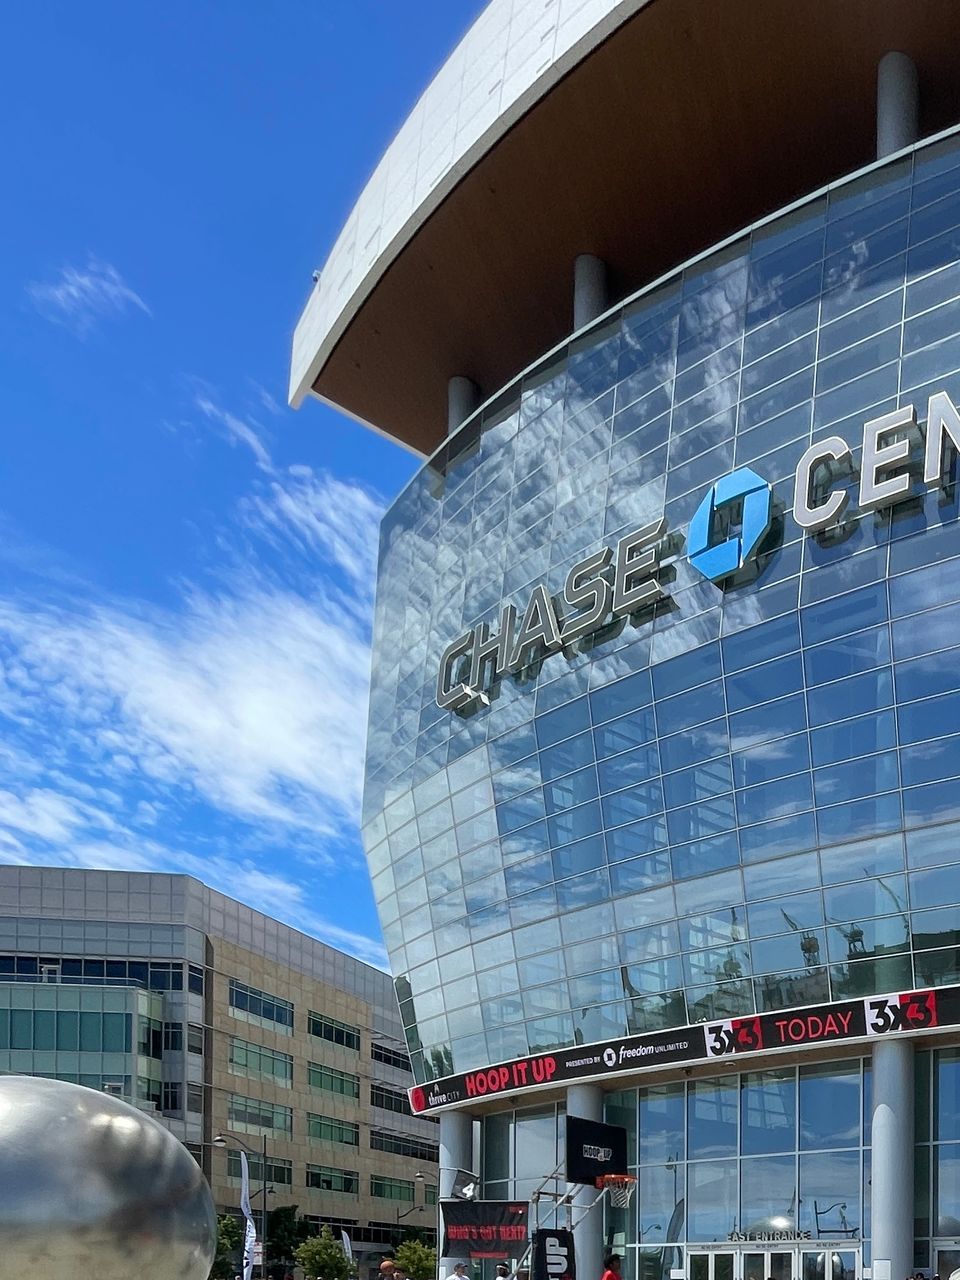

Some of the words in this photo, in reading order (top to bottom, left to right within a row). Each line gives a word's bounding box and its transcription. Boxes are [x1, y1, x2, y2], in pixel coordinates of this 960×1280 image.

[436, 516, 669, 711] CHASE
[775, 1011, 853, 1042] TODAY
[565, 1058, 593, 1068] PRESENTED
[619, 1045, 655, 1064] freedom
[655, 1042, 688, 1054] UNLIMITED
[464, 1070, 509, 1096] HOOP
[513, 1062, 527, 1086] IT
[532, 1056, 556, 1082] UP
[727, 1231, 751, 1242] EAST
[755, 1230, 810, 1242] ENTRANCE
[546, 1237, 568, 1274] UP
